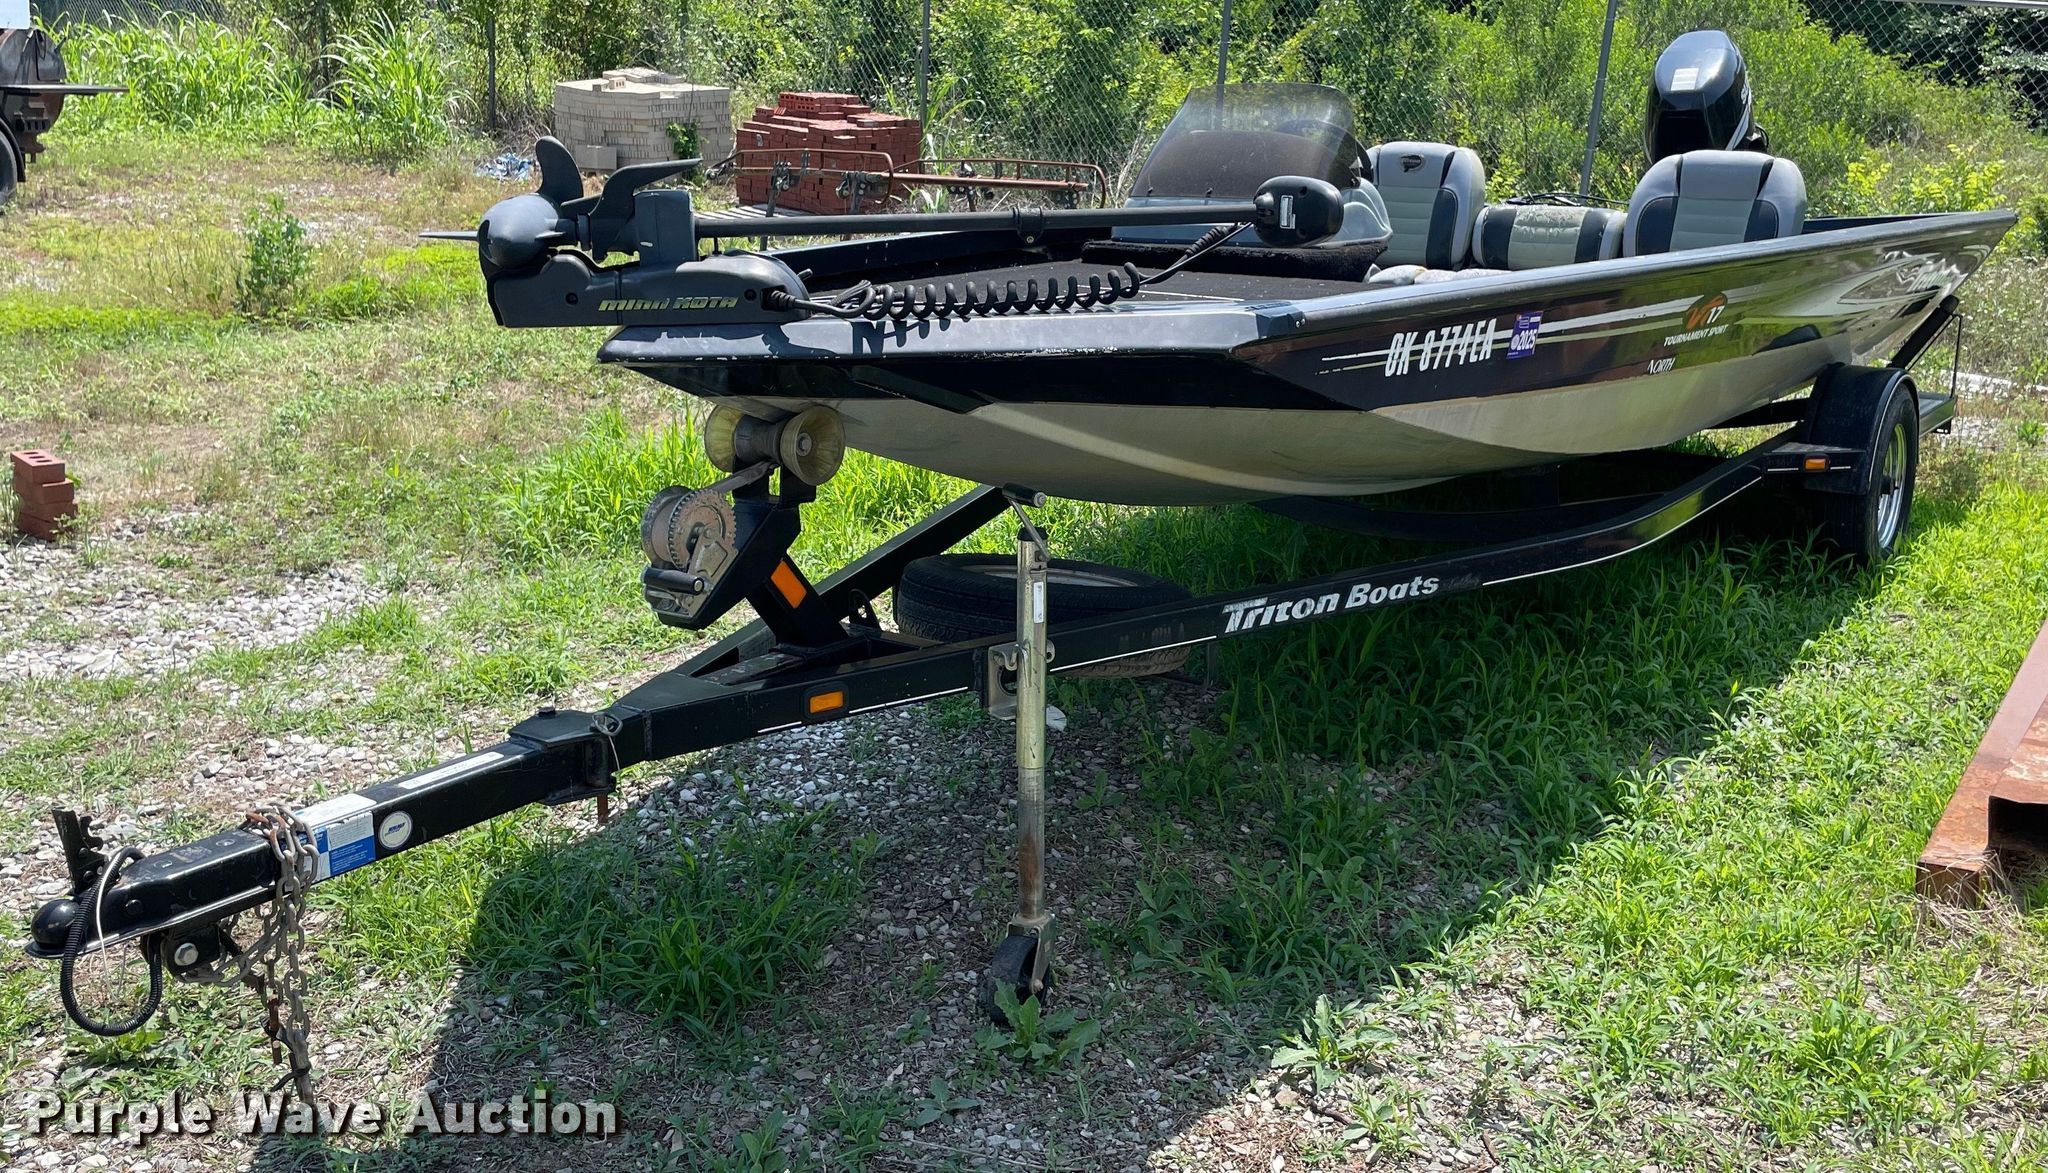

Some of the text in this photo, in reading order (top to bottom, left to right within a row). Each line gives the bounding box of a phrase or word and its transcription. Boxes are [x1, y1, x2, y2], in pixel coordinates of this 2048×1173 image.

[672, 296, 739, 309] KOTA
[1706, 305, 1726, 325] 17
[1517, 329, 1538, 351] 2025
[1663, 324, 1729, 347] TOURNAMENT SPORT
[1384, 318, 1498, 377] OK 8774EA
[1221, 593, 1341, 633] Triton
[1344, 575, 1440, 609] Boats
